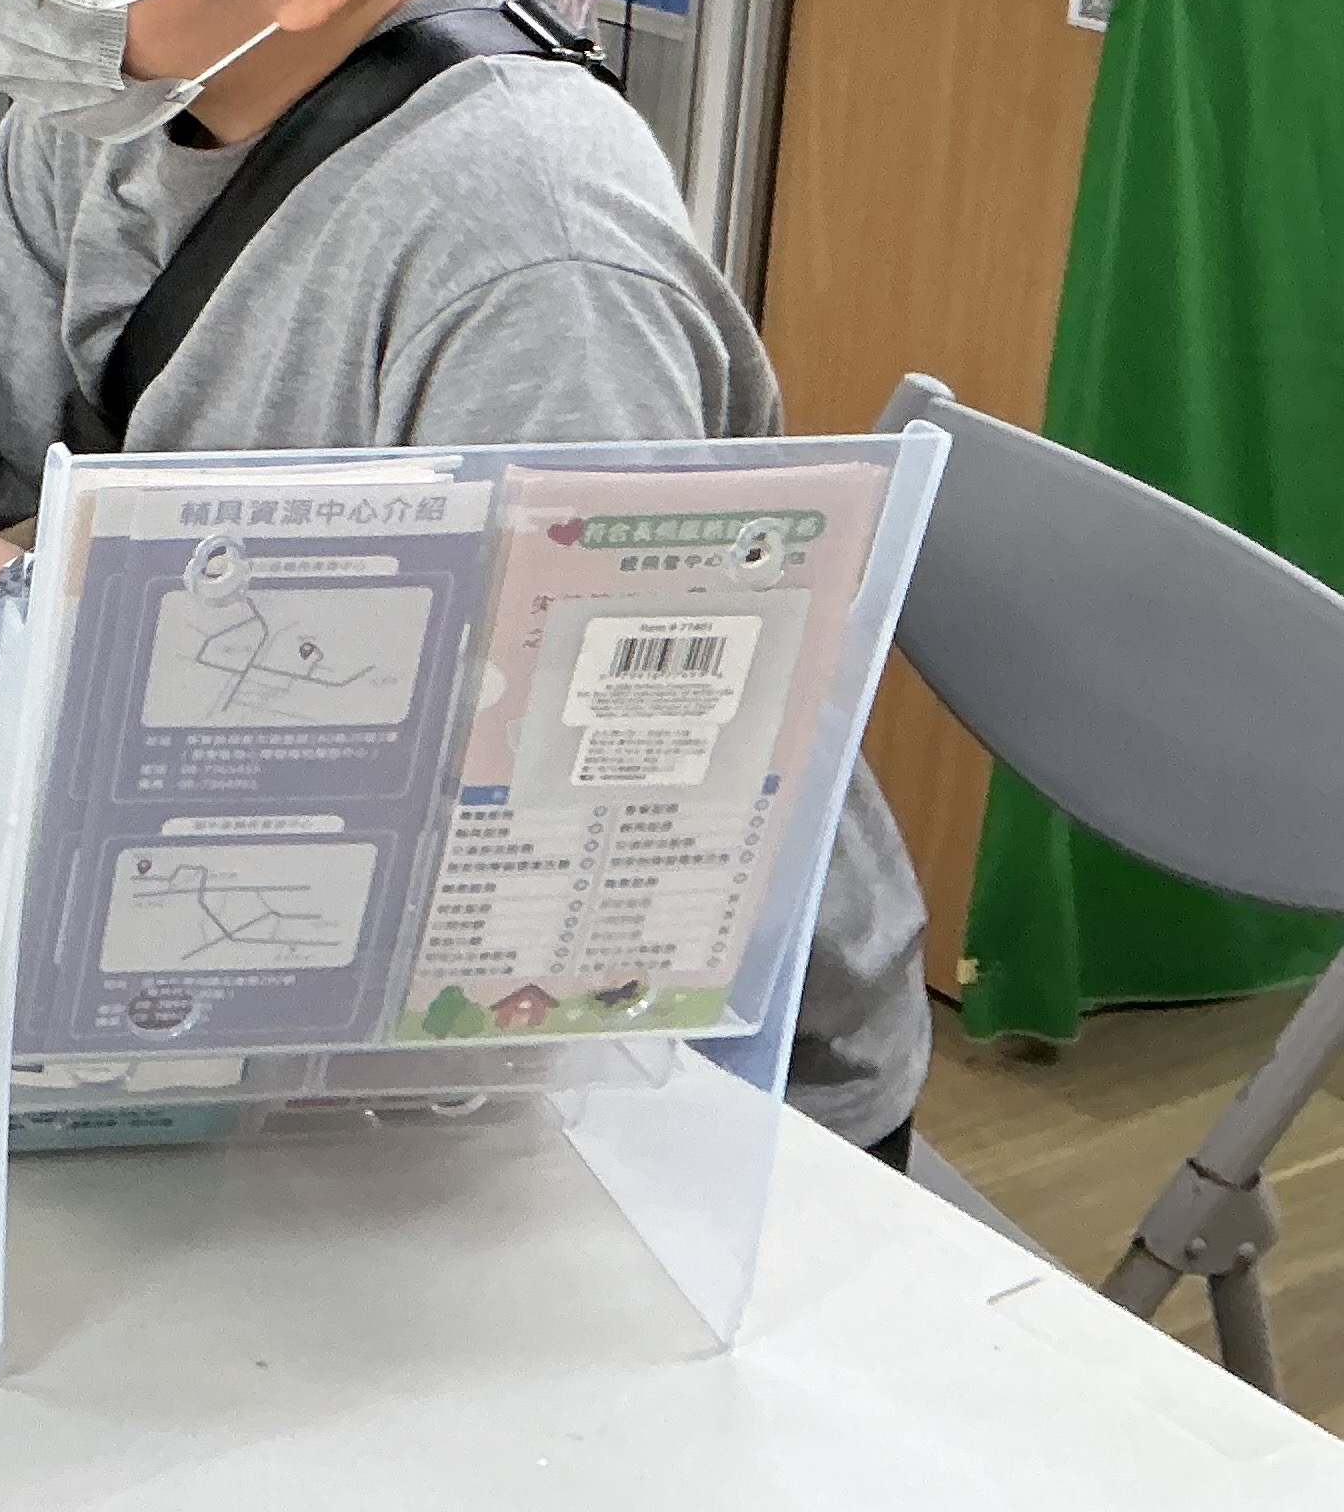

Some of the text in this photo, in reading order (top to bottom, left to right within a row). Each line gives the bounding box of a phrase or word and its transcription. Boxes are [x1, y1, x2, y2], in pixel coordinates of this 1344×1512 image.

[180, 495, 448, 527] 輔具資源中心介紹
